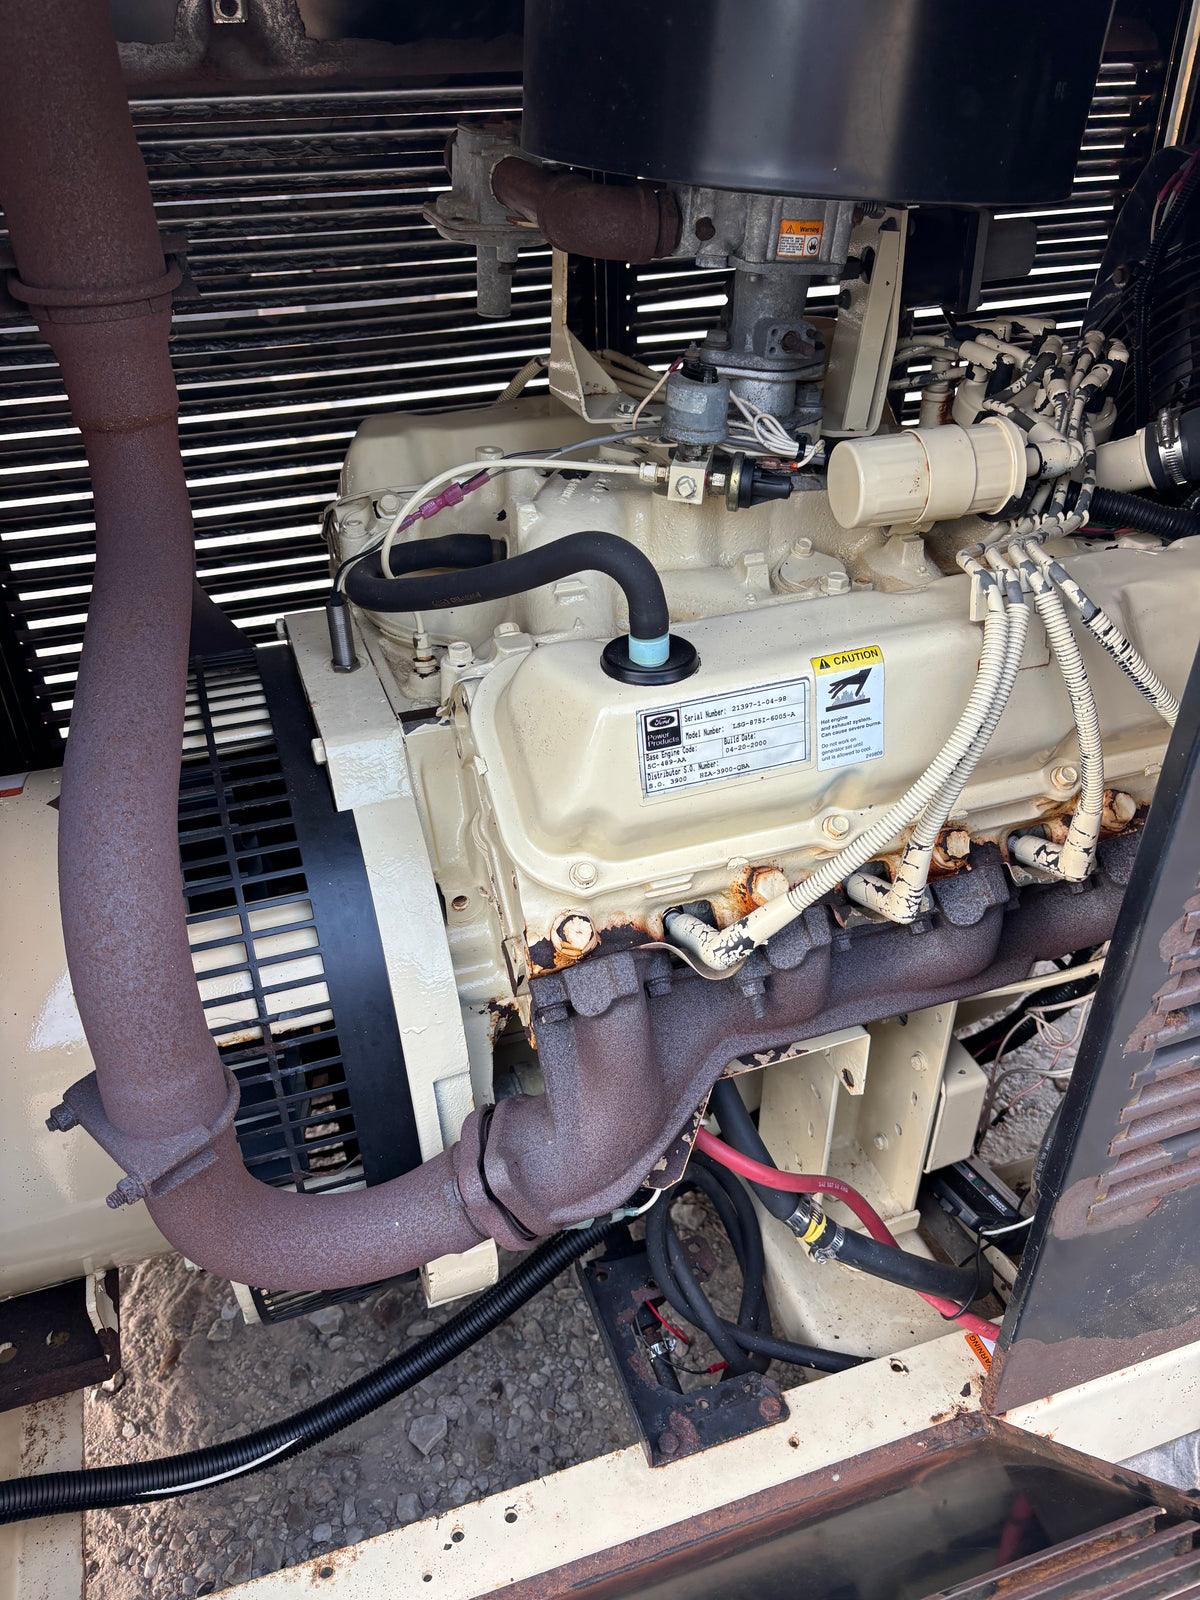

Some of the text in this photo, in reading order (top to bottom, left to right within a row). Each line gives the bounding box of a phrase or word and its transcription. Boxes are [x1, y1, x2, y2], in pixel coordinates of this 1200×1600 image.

[833, 649, 879, 666] CAUTION
[732, 695, 787, 712] 21397-1-04-98
[654, 716, 672, 726] Ford
[684, 708, 727, 722] Serial Number:
[830, 715, 848, 724] engine
[820, 720, 882, 739] Can cause severe burns.
[831, 720, 852, 730] exhaust
[852, 716, 872, 726] system.
[647, 732, 670, 741] Power
[685, 726, 725, 740] Model Number:
[724, 732, 756, 746] Build Date:
[648, 736, 680, 748] Products
[725, 739, 768, 754] 04-20-2000
[821, 746, 845, 757] generator
[852, 741, 864, 750] until
[838, 738, 850, 746] work
[646, 745, 698, 762] Base Engine Code:
[836, 749, 855, 759] allowed
[647, 768, 680, 782] Distributor
[698, 760, 720, 770] Number:
[670, 776, 688, 785] 3900
